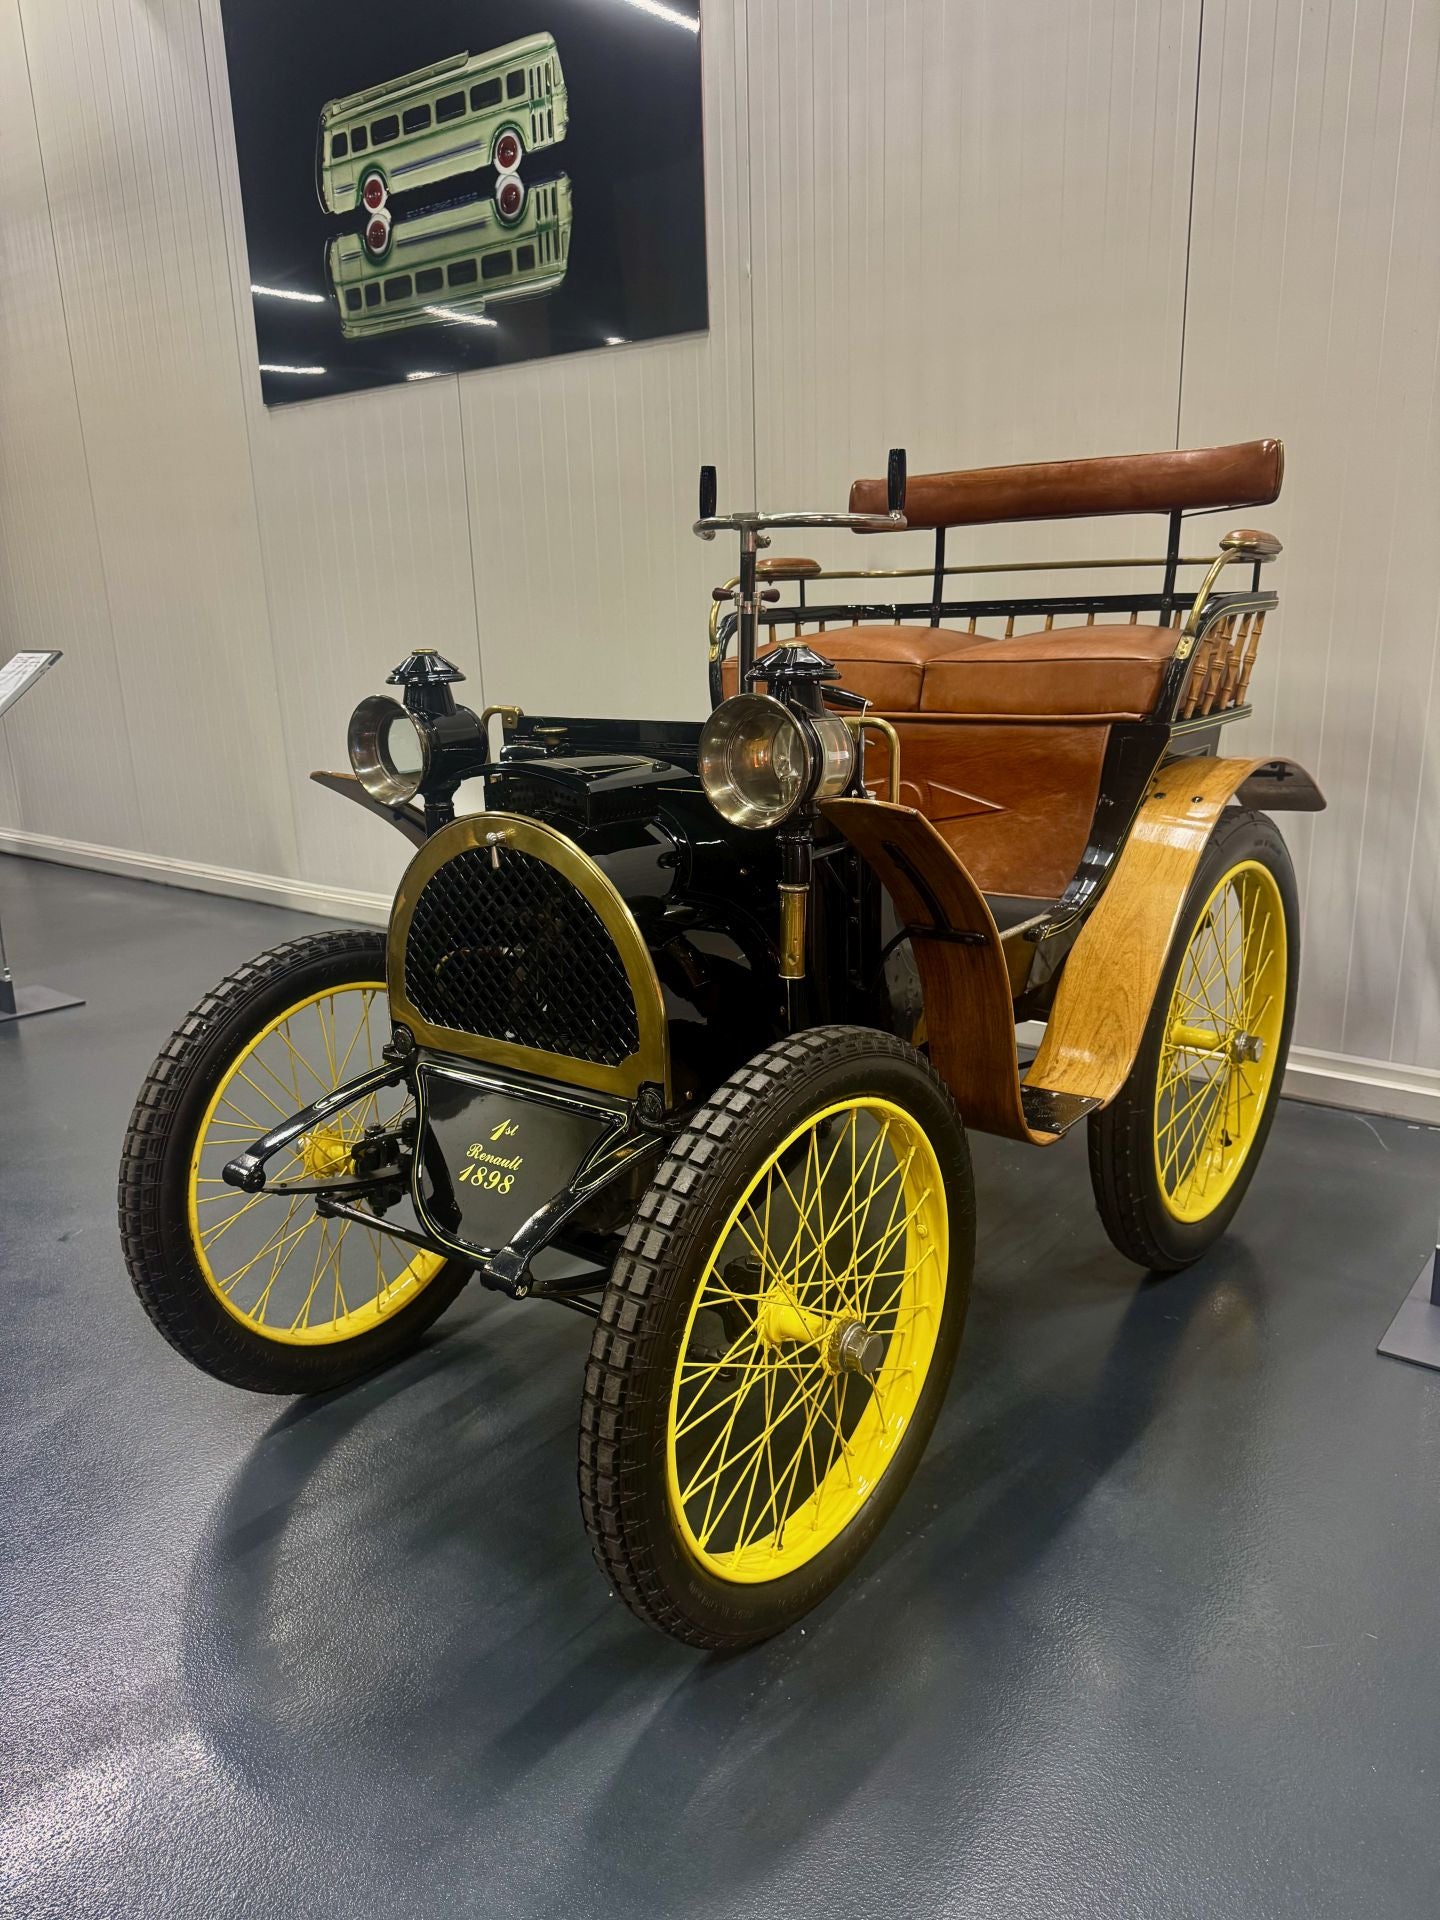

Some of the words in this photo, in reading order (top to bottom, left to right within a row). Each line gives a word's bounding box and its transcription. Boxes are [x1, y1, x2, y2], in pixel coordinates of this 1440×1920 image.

[490, 1119, 519, 1140] 1st
[466, 1143, 523, 1170] Renault
[459, 1163, 514, 1194] 1898
